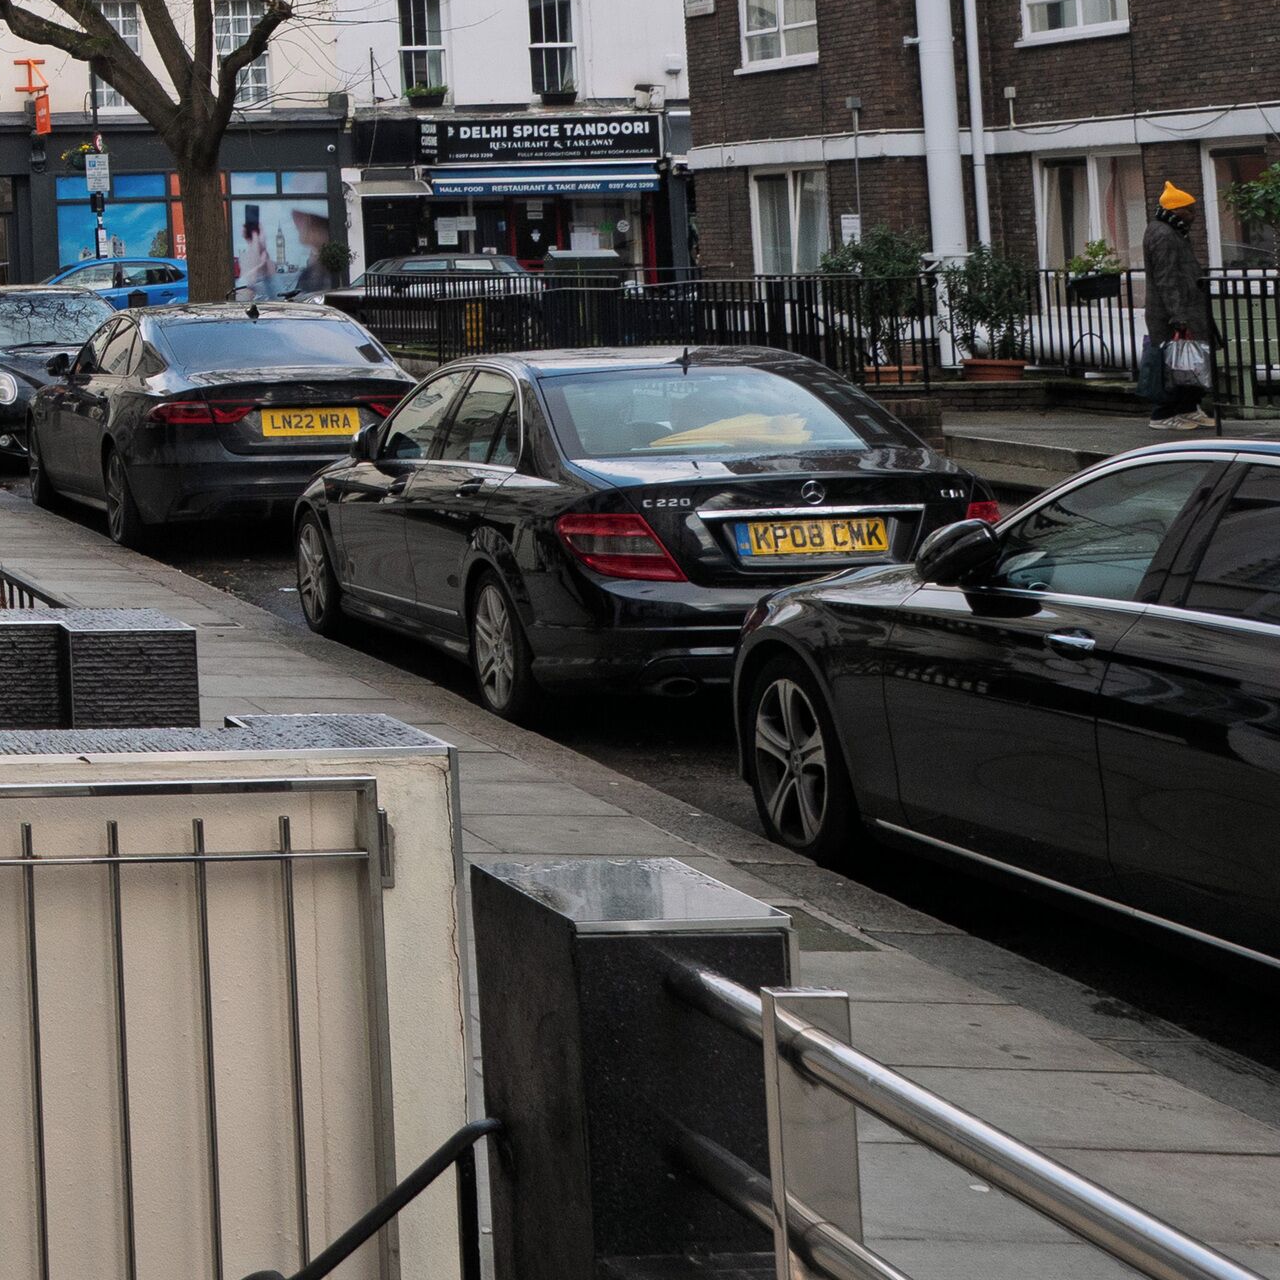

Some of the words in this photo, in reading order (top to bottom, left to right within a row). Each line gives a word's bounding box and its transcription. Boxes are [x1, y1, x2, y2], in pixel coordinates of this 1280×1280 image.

[459, 125, 508, 139] DELHI
[512, 124, 560, 138] SPICE
[563, 121, 650, 137] TANDOORI
[489, 140, 549, 151] RESTAURANT
[553, 140, 563, 149] &
[566, 138, 615, 148] TAKEAWAY
[439, 185, 462, 193] HALAL
[463, 185, 484, 193] FOOD
[491, 184, 545, 193] RESTAURANT
[547, 183, 554, 191] &
[555, 183, 577, 191] TAKE
[578, 182, 601, 190] AWAY
[270, 414, 315, 430] LN22
[319, 414, 352, 429] WRA
[642, 498, 654, 508] C
[656, 497, 691, 508] 220
[753, 522, 825, 552] KP08
[831, 520, 884, 548] CMK
